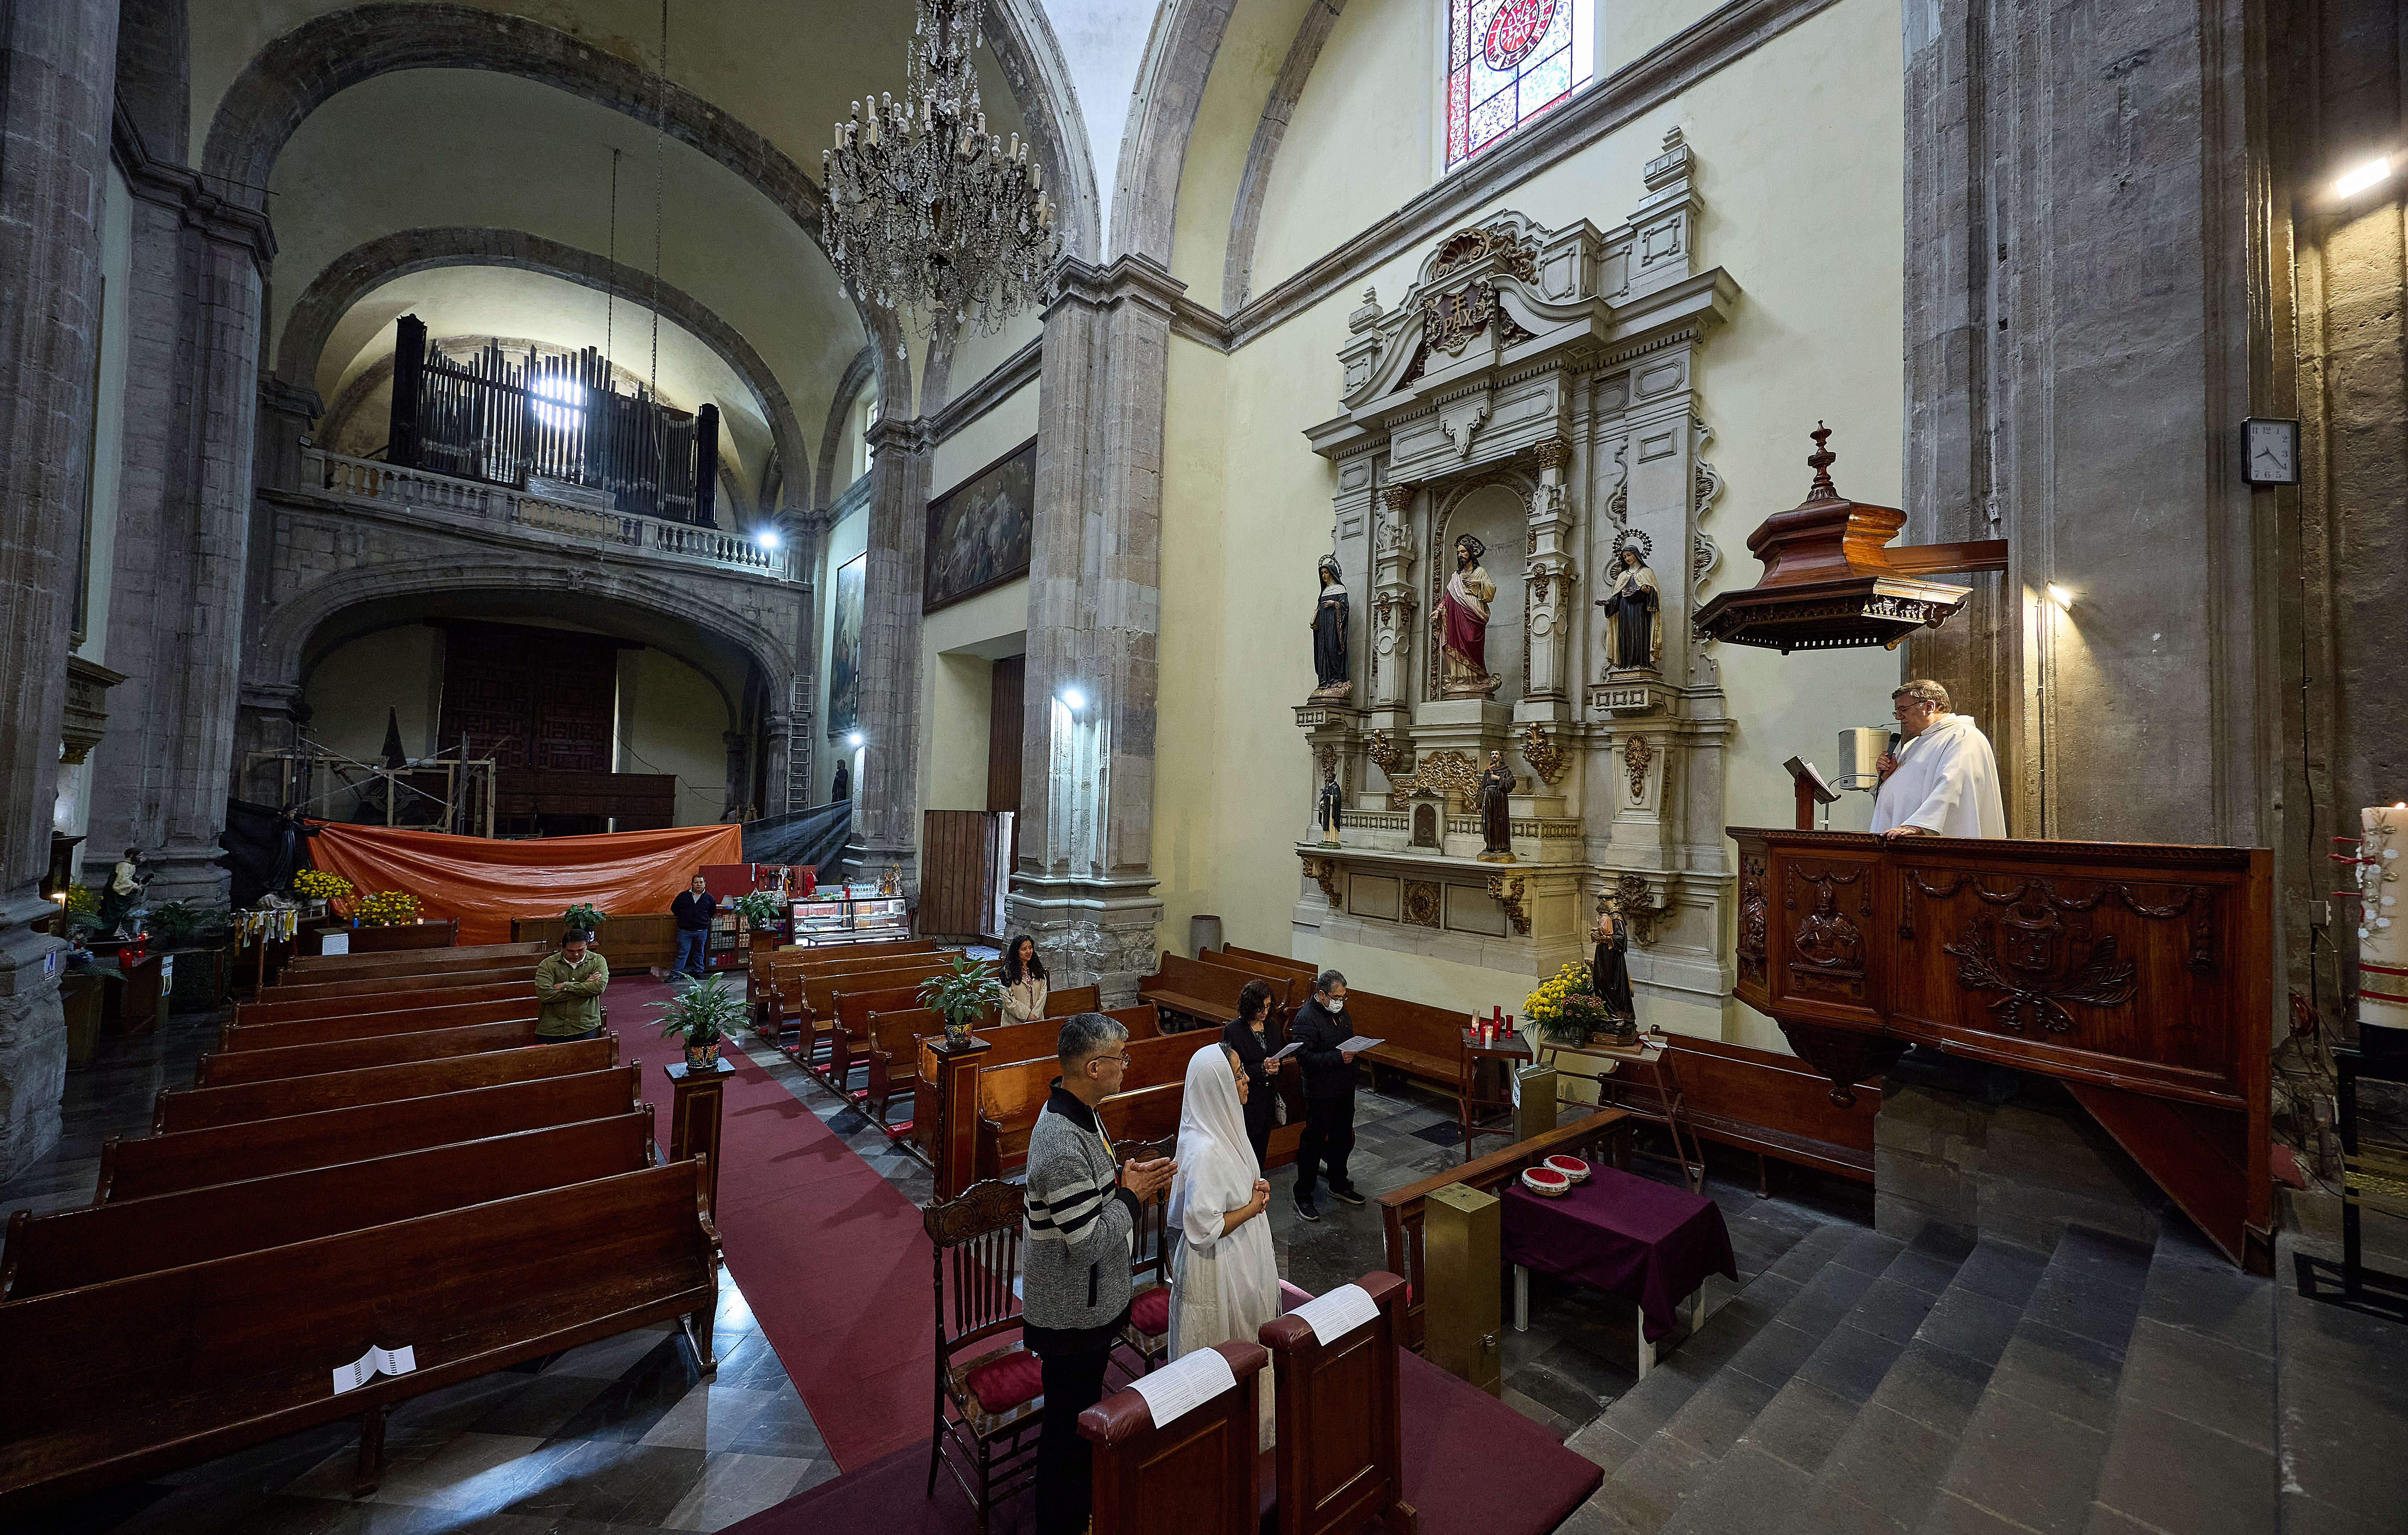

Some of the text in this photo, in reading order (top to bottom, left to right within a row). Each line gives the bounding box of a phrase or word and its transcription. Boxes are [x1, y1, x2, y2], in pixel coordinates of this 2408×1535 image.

[1443, 309, 1474, 337] PAX
[354, 1361, 362, 1385] RESERVADO
[388, 1353, 397, 1374] RESERVADO
